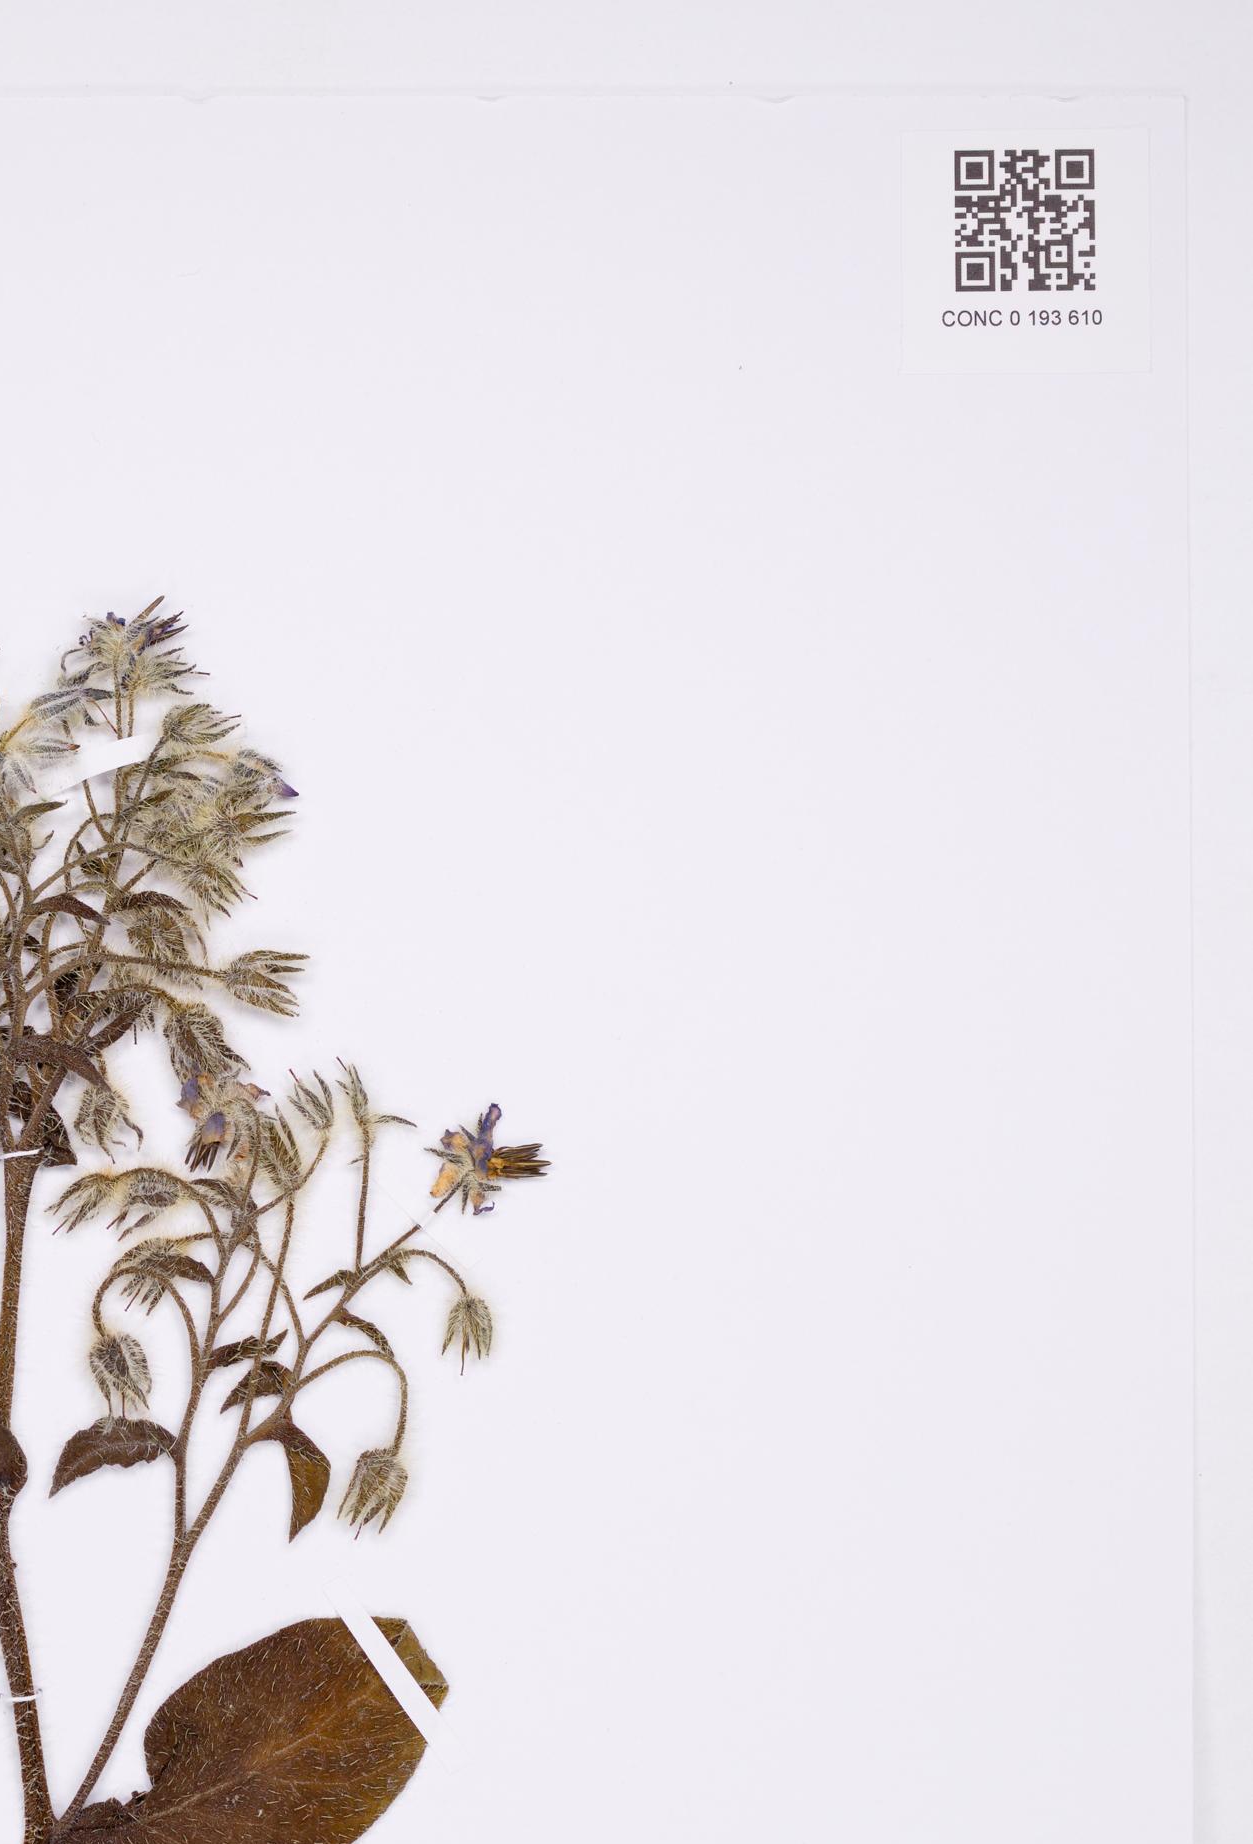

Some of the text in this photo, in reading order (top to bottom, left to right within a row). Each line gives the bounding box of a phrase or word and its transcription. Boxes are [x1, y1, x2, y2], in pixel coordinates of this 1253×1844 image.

[941, 309, 1103, 328] CONC 0 193 610
